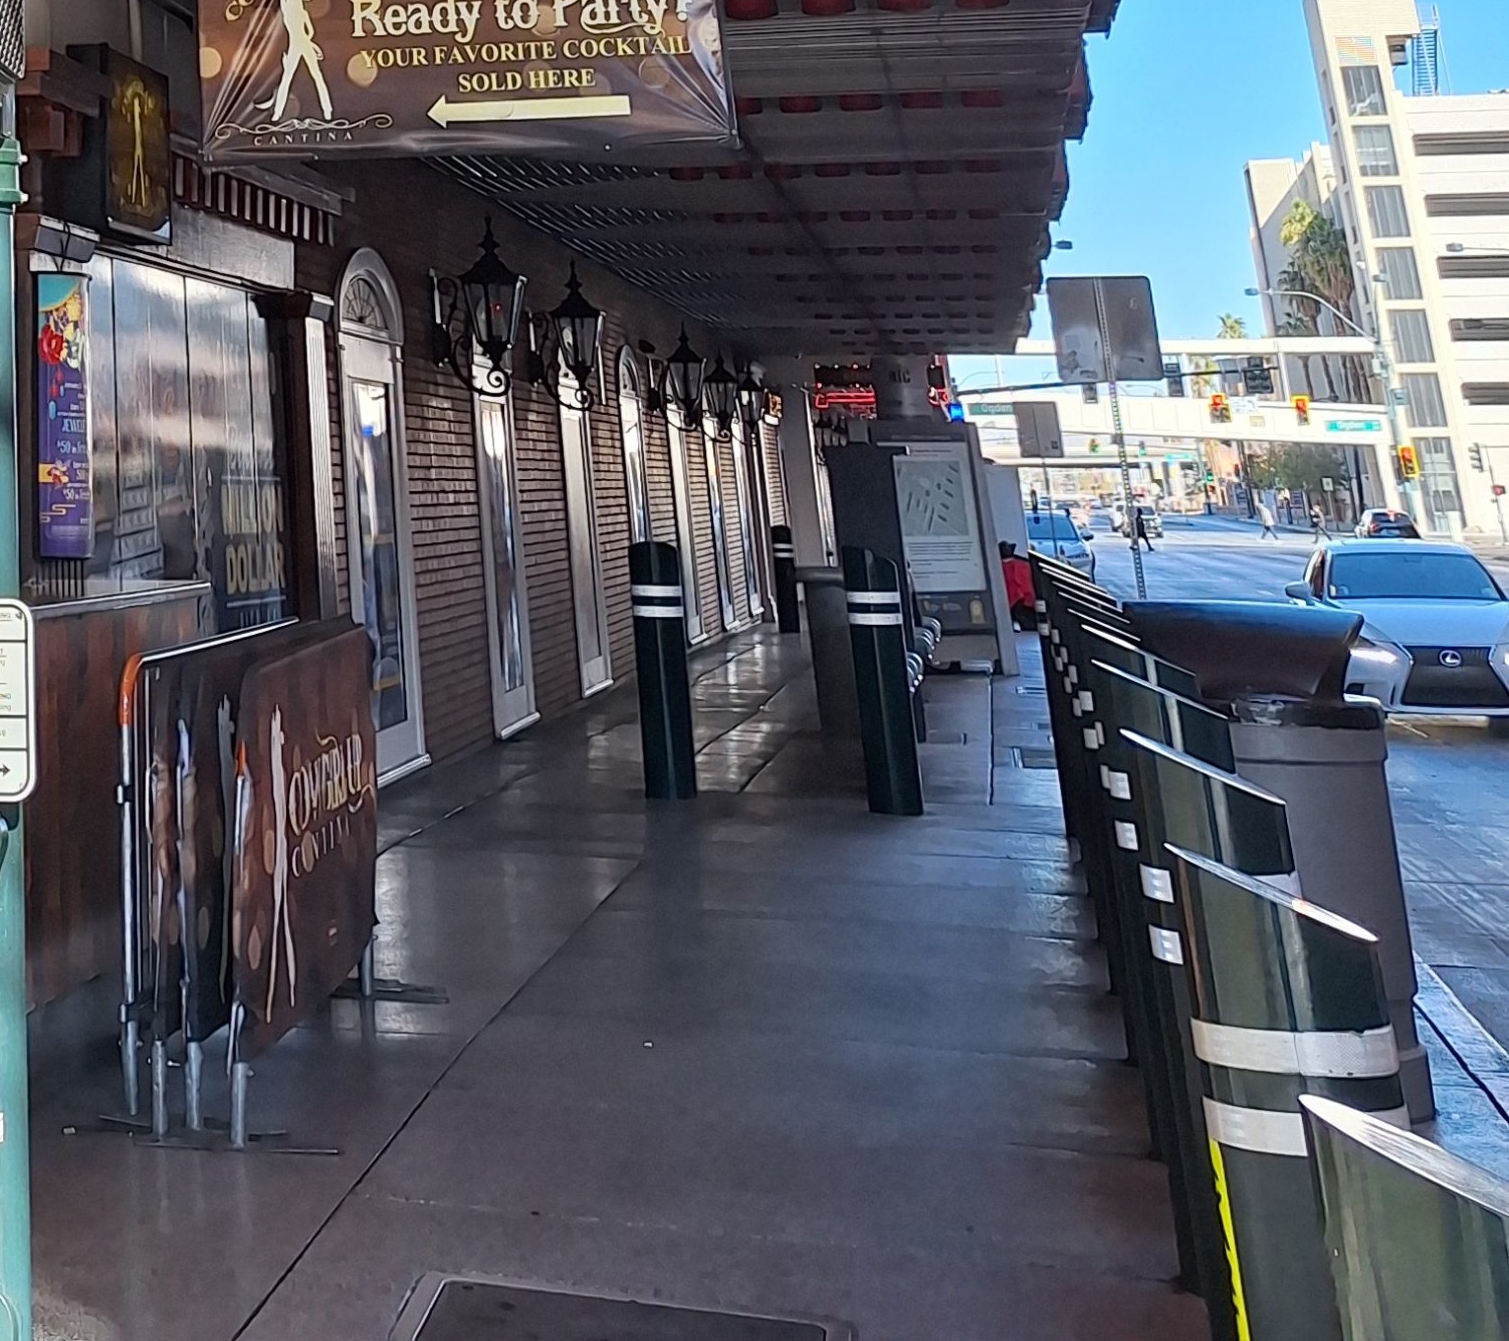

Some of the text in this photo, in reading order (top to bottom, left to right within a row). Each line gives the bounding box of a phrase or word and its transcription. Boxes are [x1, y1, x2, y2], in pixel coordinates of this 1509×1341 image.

[360, 35, 693, 69] YOUR FAVORITE COCKTAIL
[457, 68, 597, 93] SOLD HERE
[253, 130, 354, 147] CANTINA
[225, 541, 286, 596] DOLLAR
